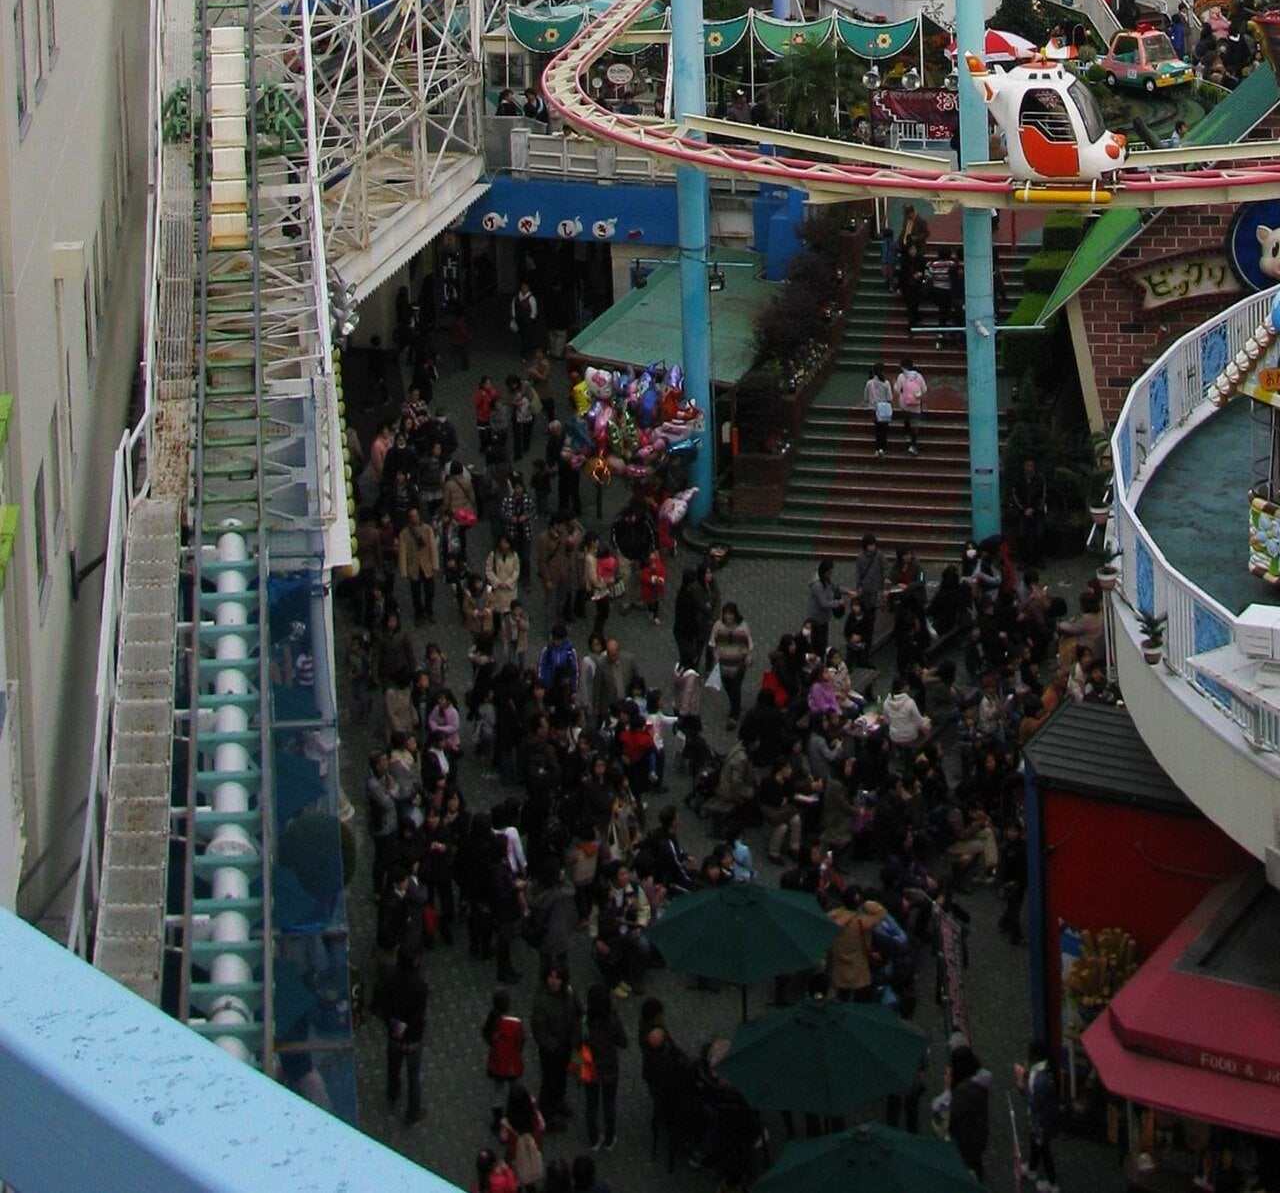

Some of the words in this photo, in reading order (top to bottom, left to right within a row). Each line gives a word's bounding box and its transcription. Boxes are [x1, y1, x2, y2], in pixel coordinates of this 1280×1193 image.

[1143, 261, 1226, 297] ビックリ
[1200, 1051, 1237, 1073] FOOD
